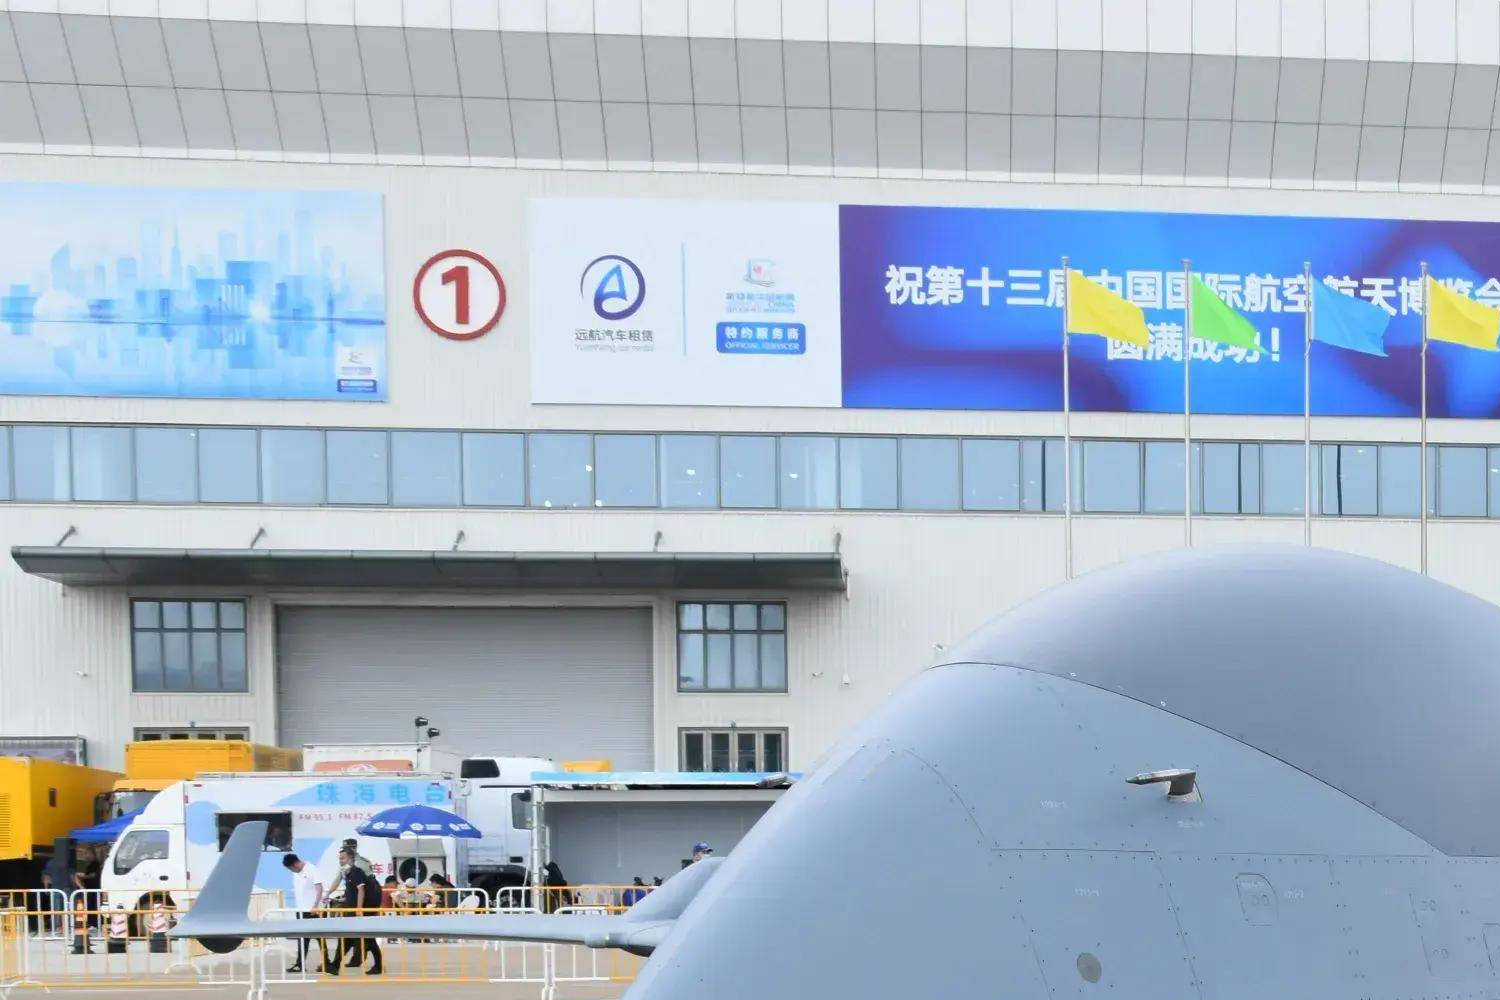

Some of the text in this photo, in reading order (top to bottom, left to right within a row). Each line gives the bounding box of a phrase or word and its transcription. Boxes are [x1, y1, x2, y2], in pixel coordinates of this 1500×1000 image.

[442, 265, 469, 325] 1
[317, 783, 445, 804] 珠海电台
